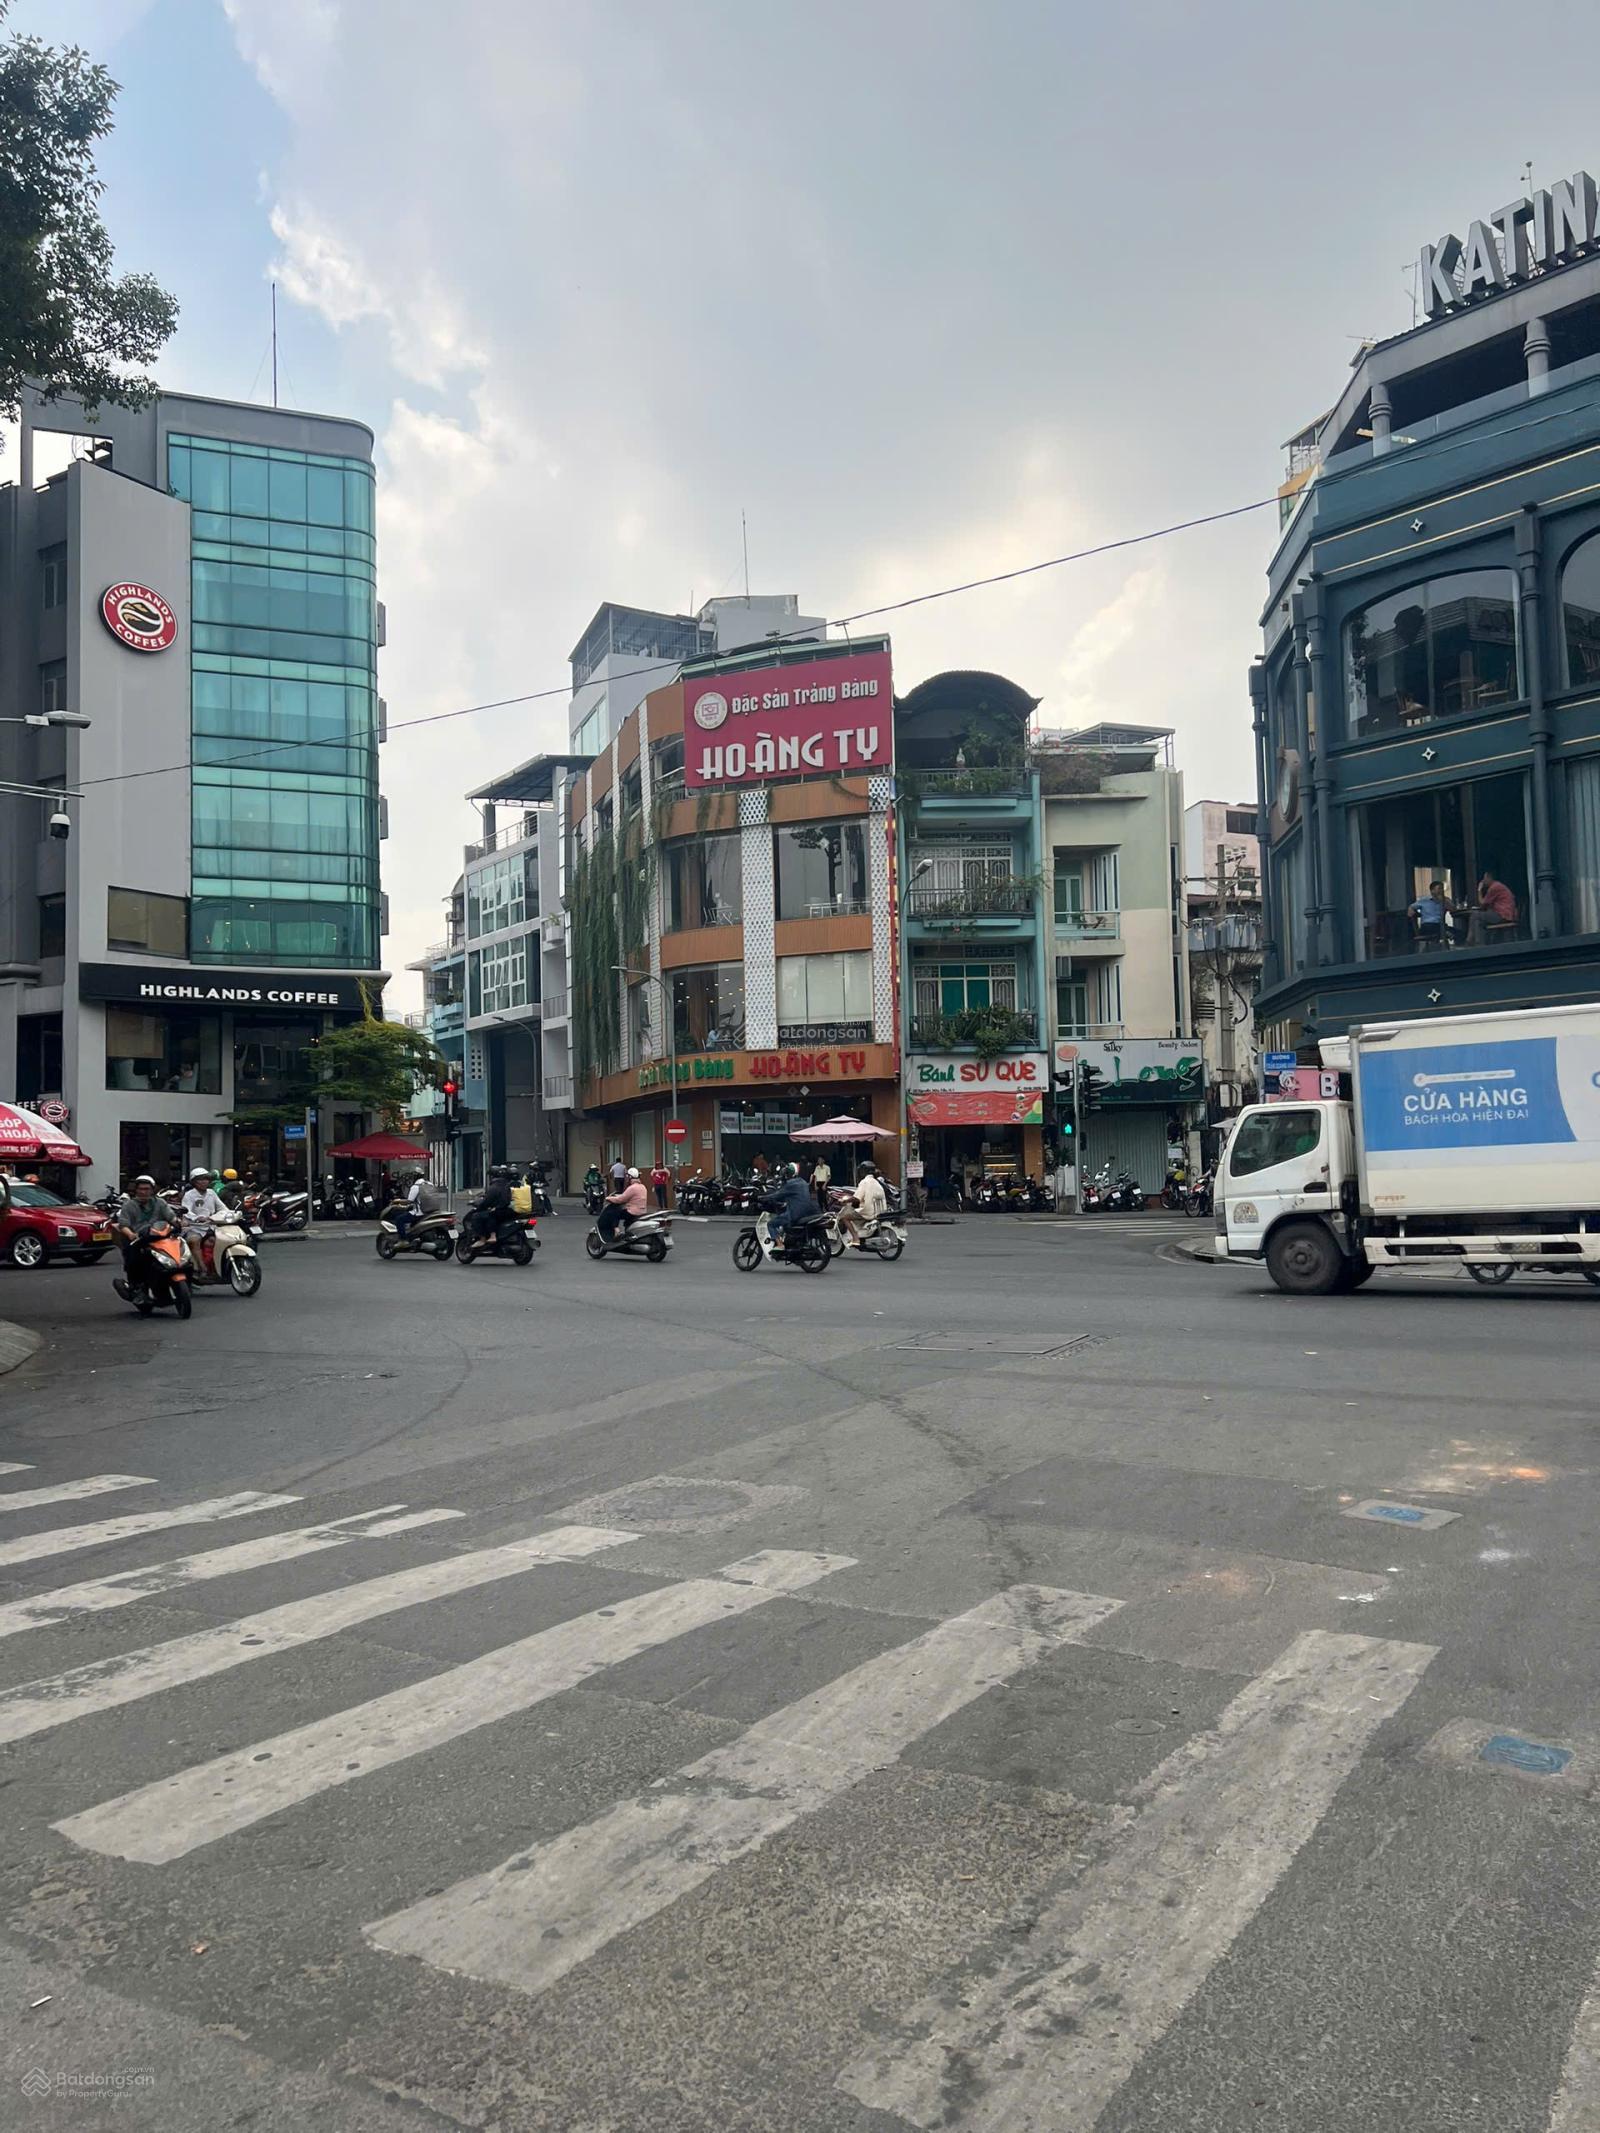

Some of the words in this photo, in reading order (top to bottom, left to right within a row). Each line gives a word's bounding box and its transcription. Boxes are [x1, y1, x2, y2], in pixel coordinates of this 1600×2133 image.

[1421, 170, 1600, 315] KATIN
[108, 586, 173, 624] HIGHLANDS
[116, 624, 166, 647] COFFEE
[732, 694, 759, 716] Đặc
[762, 688, 789, 710] Sản
[793, 682, 836, 705] Trảng
[841, 678, 878, 699] Bảng
[696, 732, 824, 780] HOÀNG
[833, 726, 878, 764] TY
[140, 984, 261, 1001] HIGHLANDS
[267, 990, 339, 1005] COFFEE
[917, 1064, 955, 1082] Bánh
[960, 1061, 989, 1081] SU
[996, 1060, 1037, 1081] QUE
[1321, 1073, 1340, 1097] B
[1404, 1087, 1452, 1112] CỬA
[1460, 1086, 1528, 1110] HÀNG
